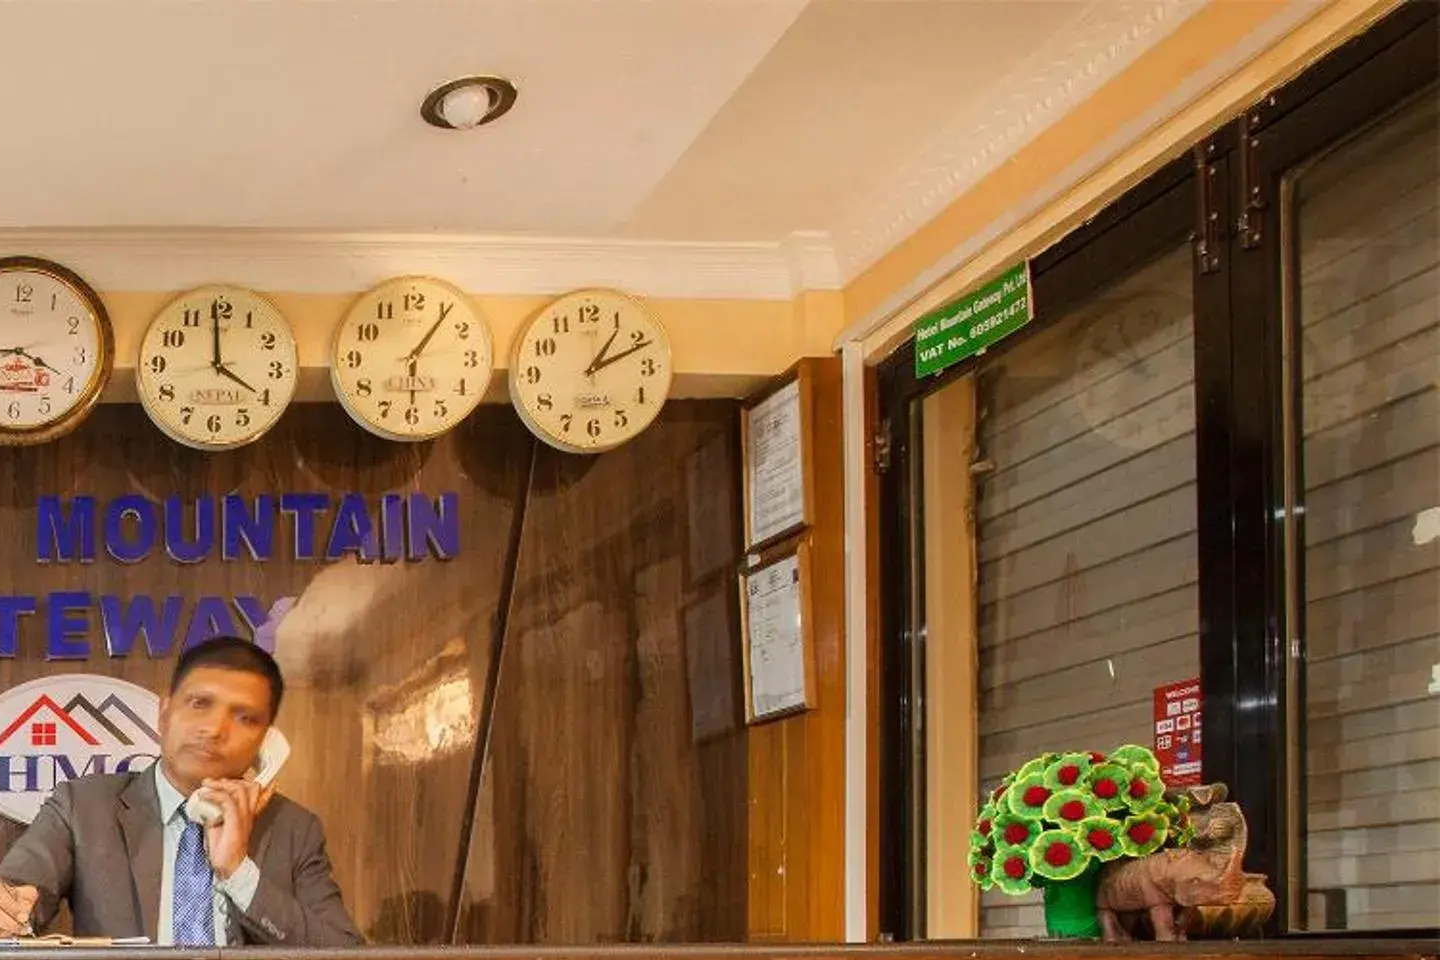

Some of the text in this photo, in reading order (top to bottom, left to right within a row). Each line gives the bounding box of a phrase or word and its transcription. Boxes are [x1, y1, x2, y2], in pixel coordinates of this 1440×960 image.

[14, 285, 33, 302] 12
[403, 293, 425, 311] 12
[183, 309, 200, 327] 11
[377, 302, 393, 319] 11
[579, 305, 600, 323] 12
[68, 317, 79, 334] 2
[358, 324, 379, 341] 10
[455, 322, 469, 339] 2
[553, 317, 569, 333] 11
[162, 330, 184, 347] 10
[261, 333, 275, 350] 2
[535, 338, 555, 356] 10
[73, 347, 85, 364] 3
[919, 343, 945, 362] VAT
[947, 335, 967, 351] No.
[151, 356, 165, 373] 9
[348, 351, 362, 368] 9
[464, 351, 478, 367] 3
[641, 359, 655, 376] 3
[269, 361, 283, 379] 3
[527, 366, 540, 384] 9
[62, 377, 74, 393] 4
[159, 384, 175, 401] 8
[356, 378, 371, 396] 8
[453, 378, 466, 395] 4
[257, 389, 270, 406] 4
[537, 394, 553, 411] 8
[634, 387, 644, 404] 4
[8, 402, 20, 419] 6
[39, 397, 51, 413] 5
[378, 401, 392, 418] 7
[434, 401, 448, 417] 5
[180, 406, 194, 424] 7
[236, 409, 250, 426] 5
[405, 408, 419, 425] 6
[560, 414, 573, 432] 7
[615, 411, 627, 427] 5
[207, 416, 221, 433] 6
[587, 419, 601, 436] 6
[35, 492, 462, 565] MOUNTAIN
